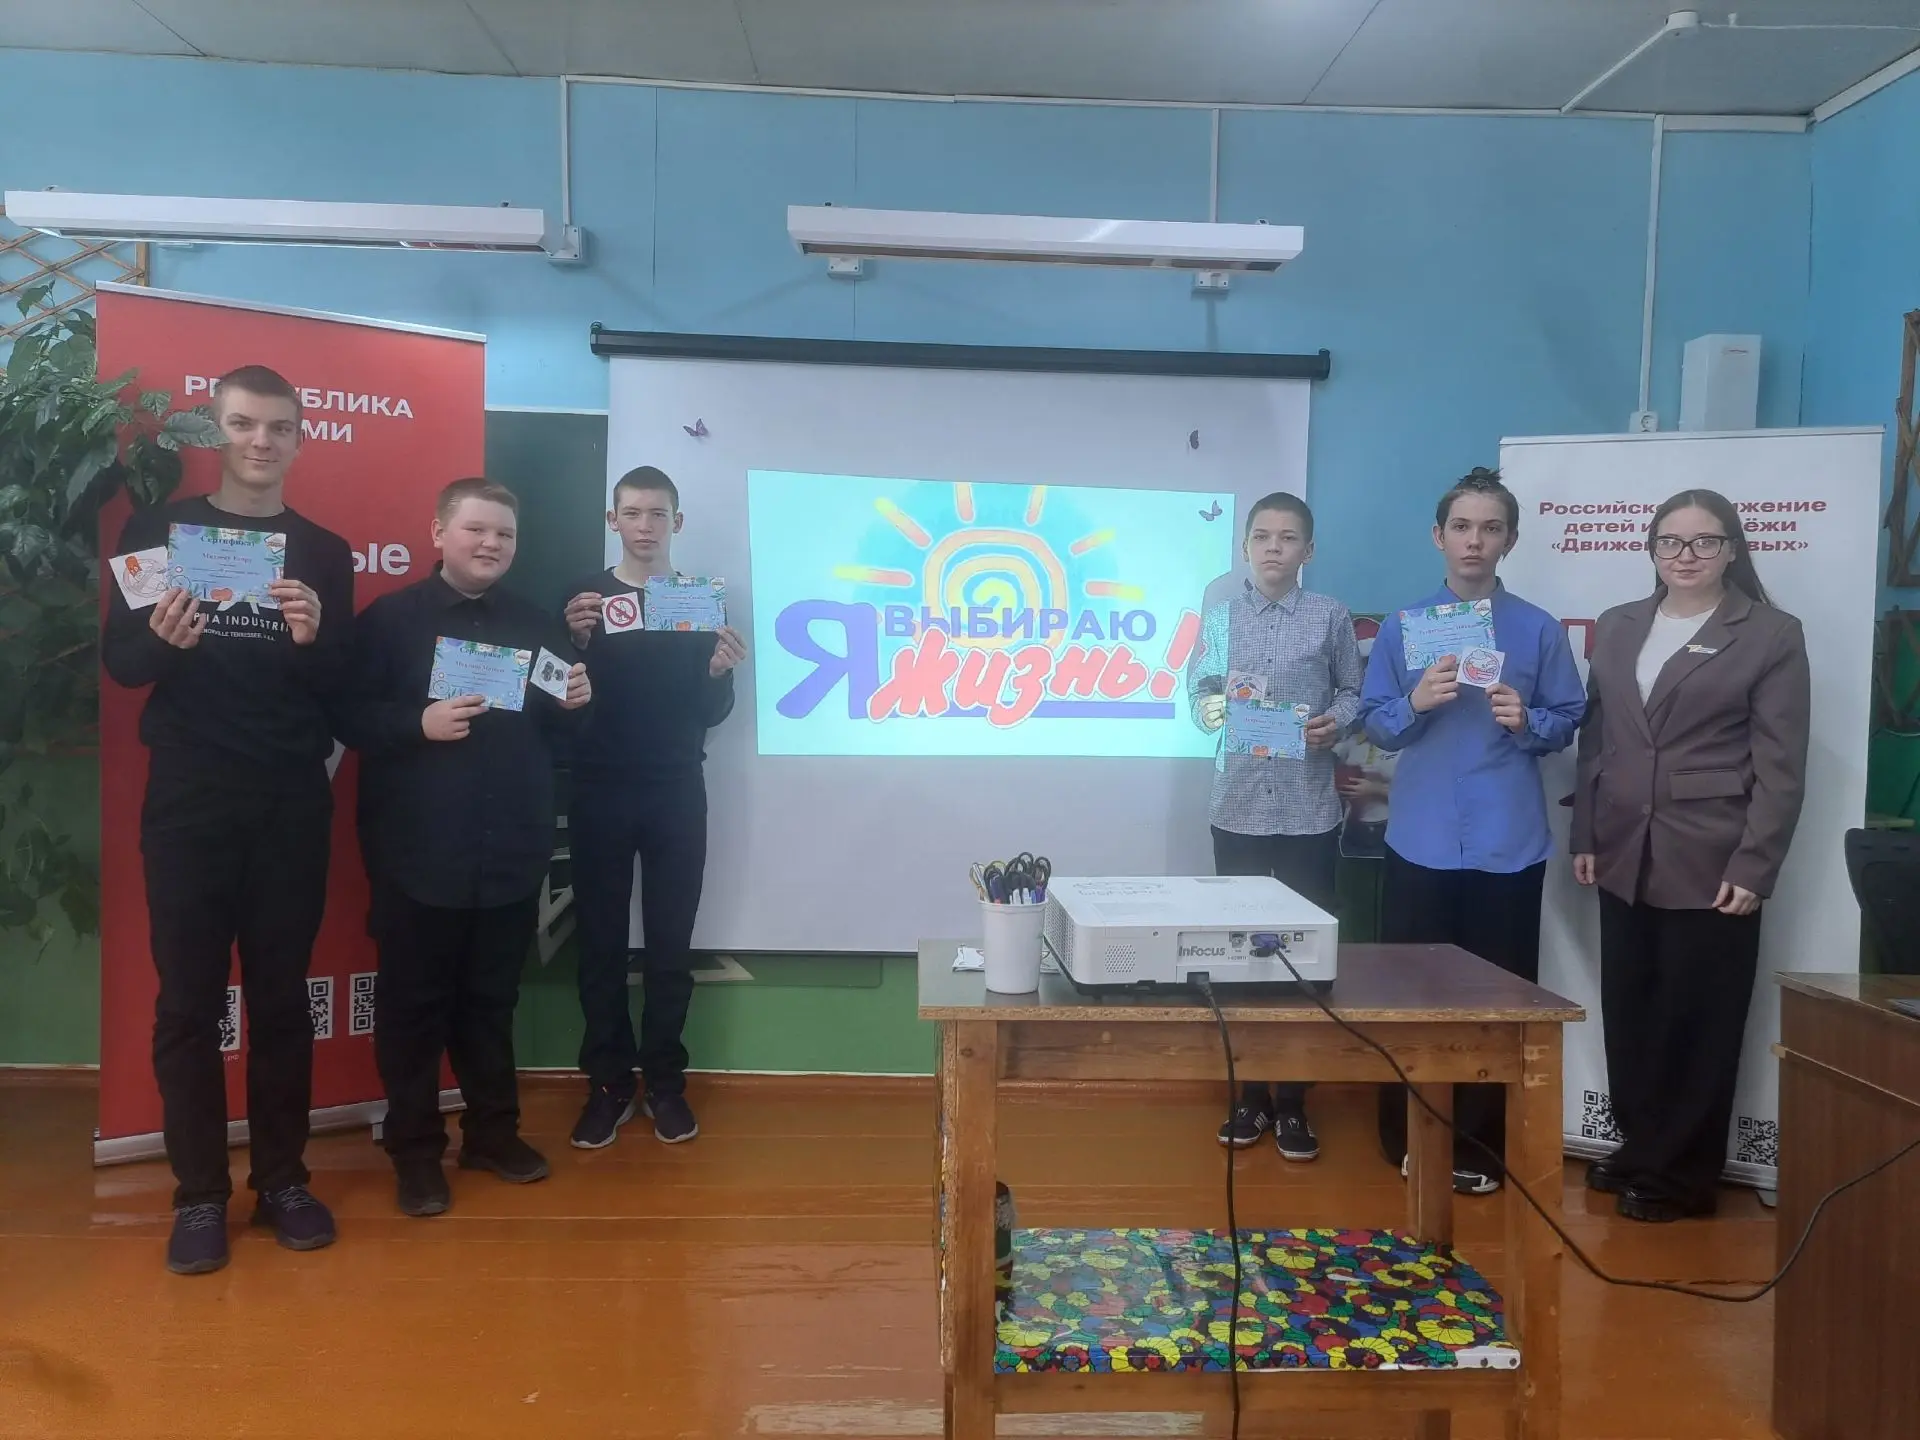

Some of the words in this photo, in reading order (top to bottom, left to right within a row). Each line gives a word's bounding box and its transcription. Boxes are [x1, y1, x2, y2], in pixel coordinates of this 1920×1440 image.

[1539, 500, 1660, 515] Российск
[1564, 519, 1635, 535] детей
[1551, 538, 1649, 553] «Движе
[226, 615, 289, 633] INDUSTRI
[774, 599, 881, 720] Я
[884, 604, 1156, 643] ВЫБИРАЮ
[1179, 946, 1226, 956] InFocus
